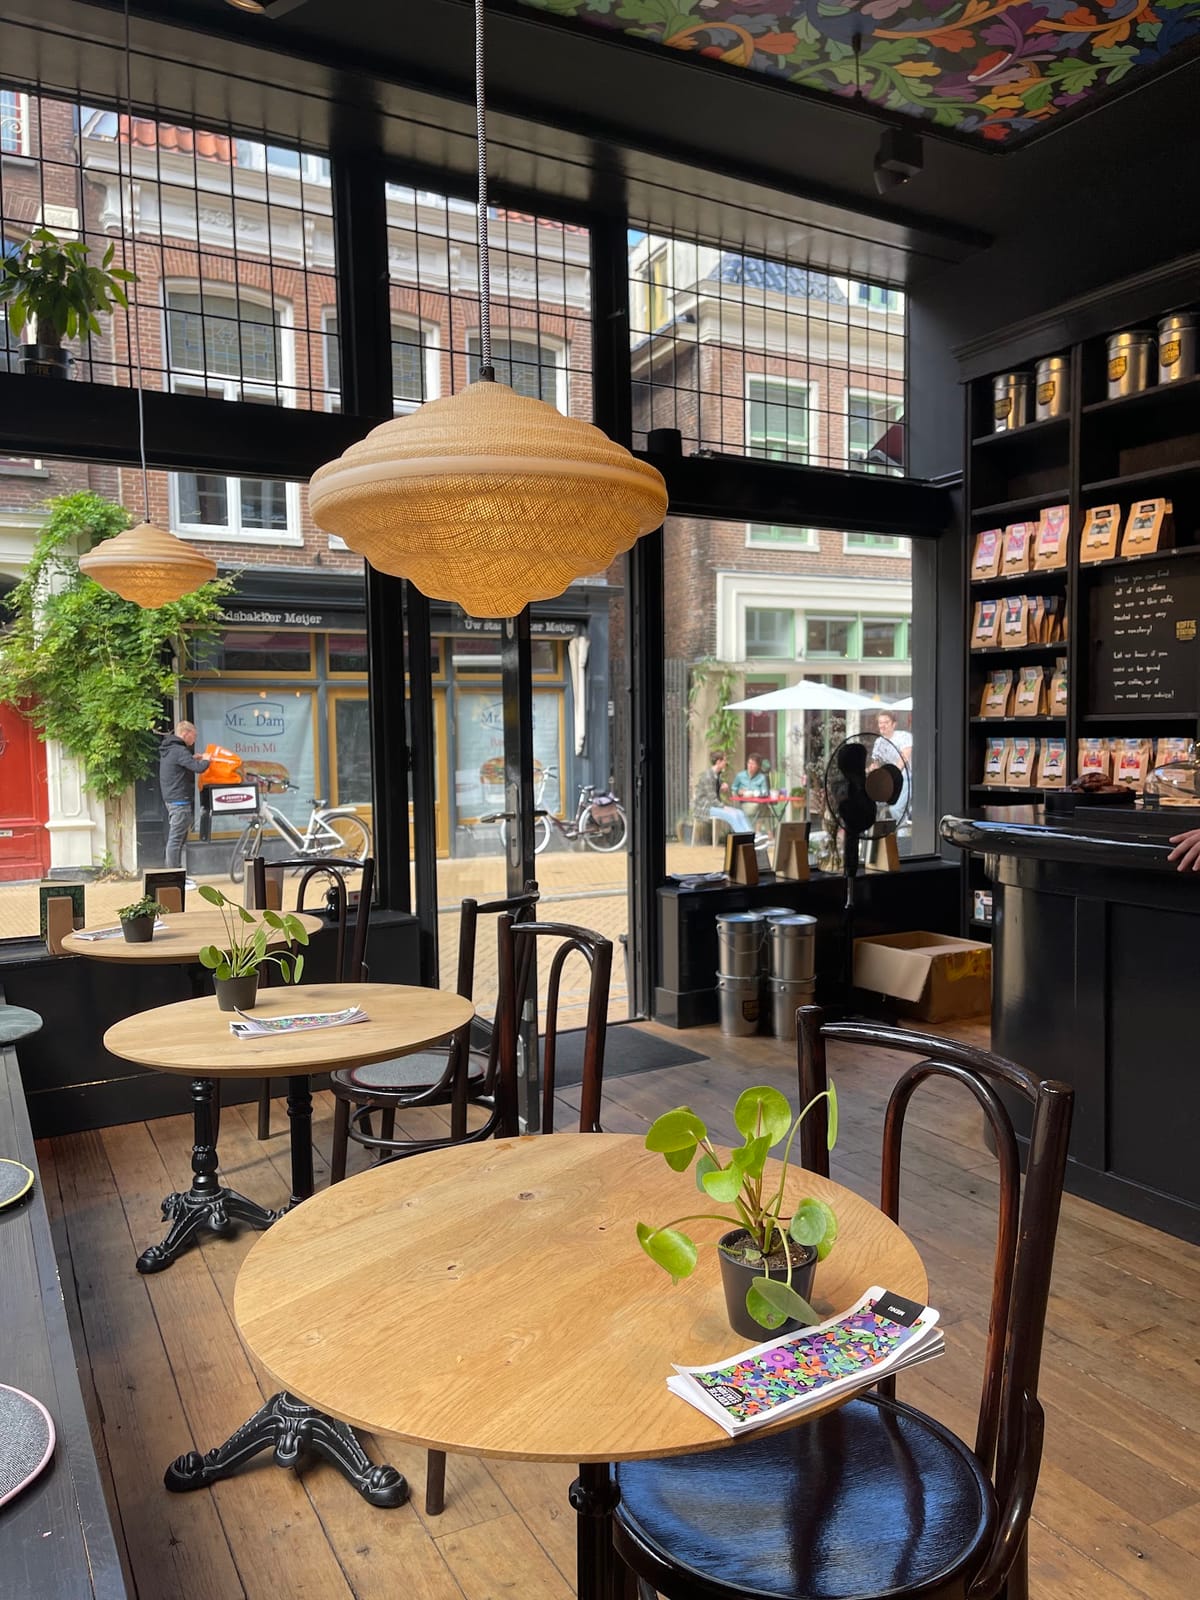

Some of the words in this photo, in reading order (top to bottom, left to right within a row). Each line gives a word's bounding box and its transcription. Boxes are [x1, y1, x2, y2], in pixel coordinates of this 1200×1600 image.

[1132, 575, 1143, 585] you
[1157, 569, 1170, 578] find
[284, 612, 322, 626] Meijer
[464, 620, 482, 630] Uw
[545, 621, 576, 634] Meijer
[225, 713, 246, 726] Mr.
[256, 714, 284, 726] Dam
